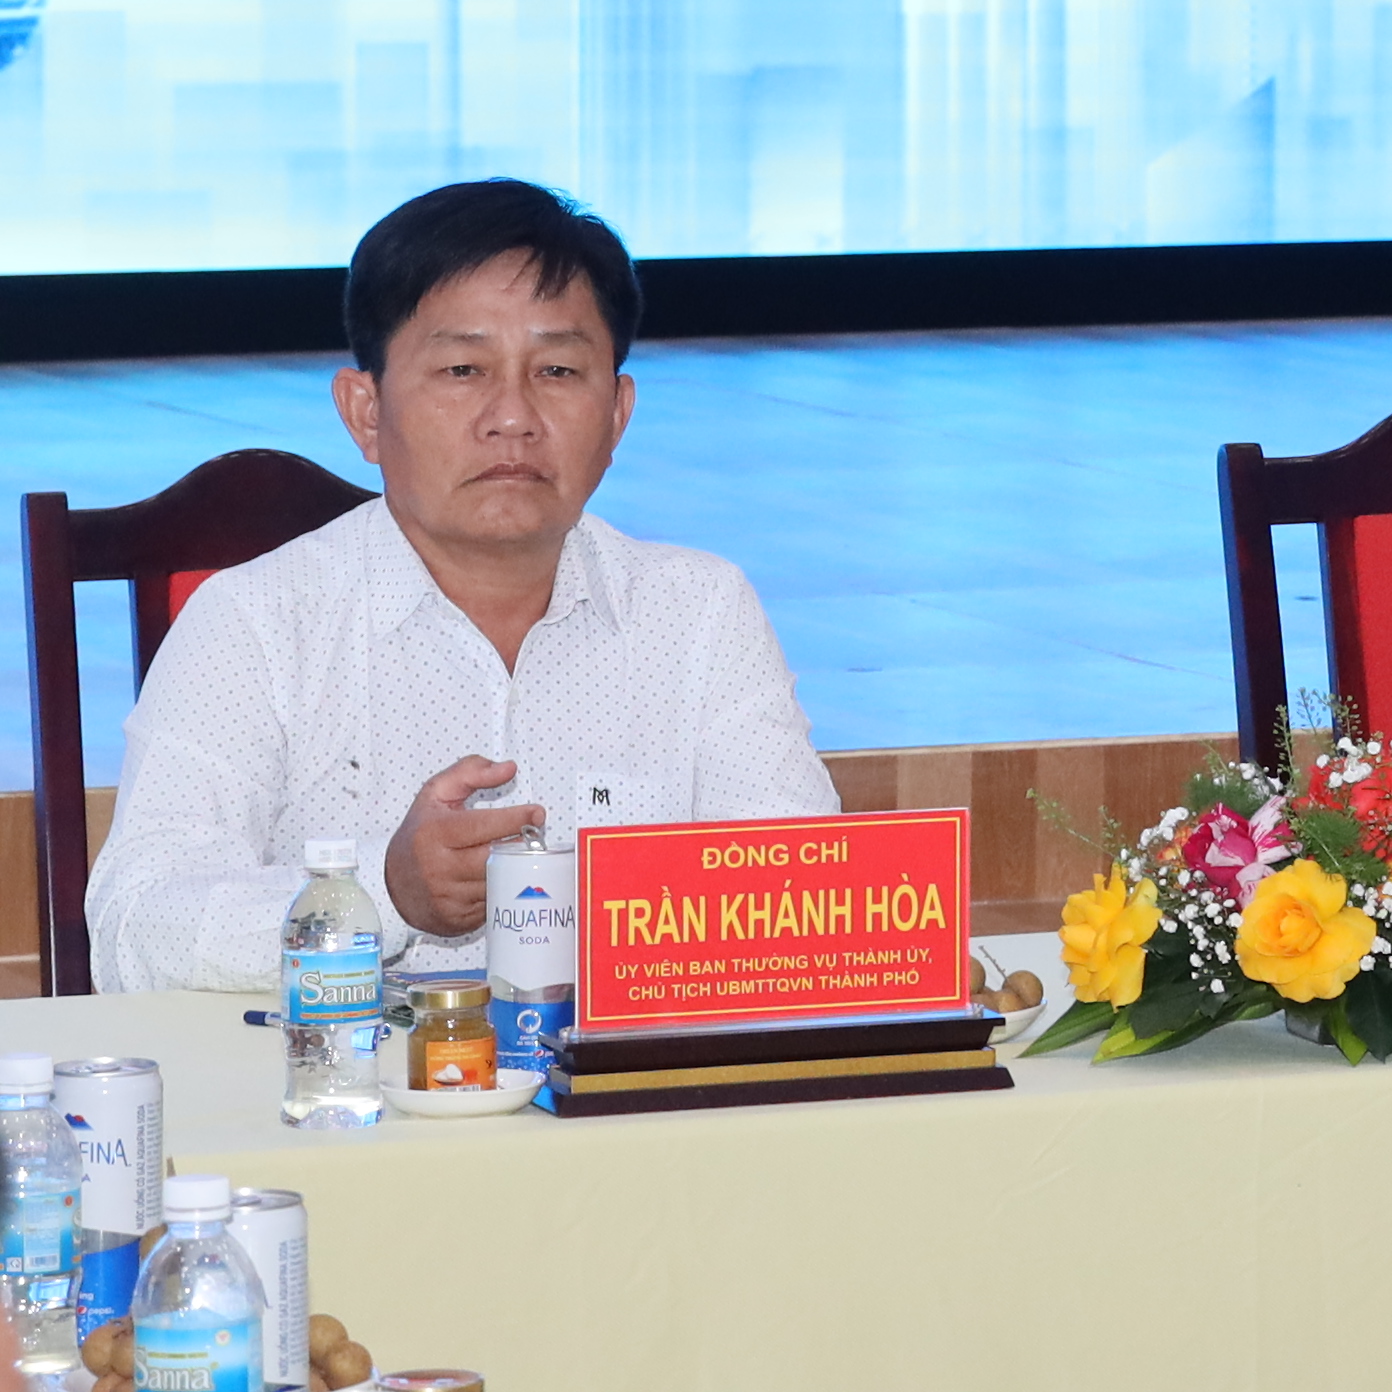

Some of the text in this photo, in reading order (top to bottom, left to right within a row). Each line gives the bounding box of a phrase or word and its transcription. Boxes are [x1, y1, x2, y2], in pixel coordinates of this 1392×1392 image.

[701, 836, 847, 869] ĐỒNG CHÍ
[493, 904, 575, 932] AQUAFINA
[604, 873, 945, 946] TRẦN KHÁNH HÒA
[519, 936, 550, 945] SODA
[616, 948, 932, 979] ỦY VIÊN BAN THƯỜNG VỤ THÀNH ỦY,
[301, 971, 378, 1005] Sanna
[629, 986, 665, 1000] CHỦ
[672, 983, 710, 1000] TỊCH
[717, 977, 812, 995] UBMTTQVN
[819, 971, 877, 989] THÀNH
[135, 1346, 213, 1391] Sanna
